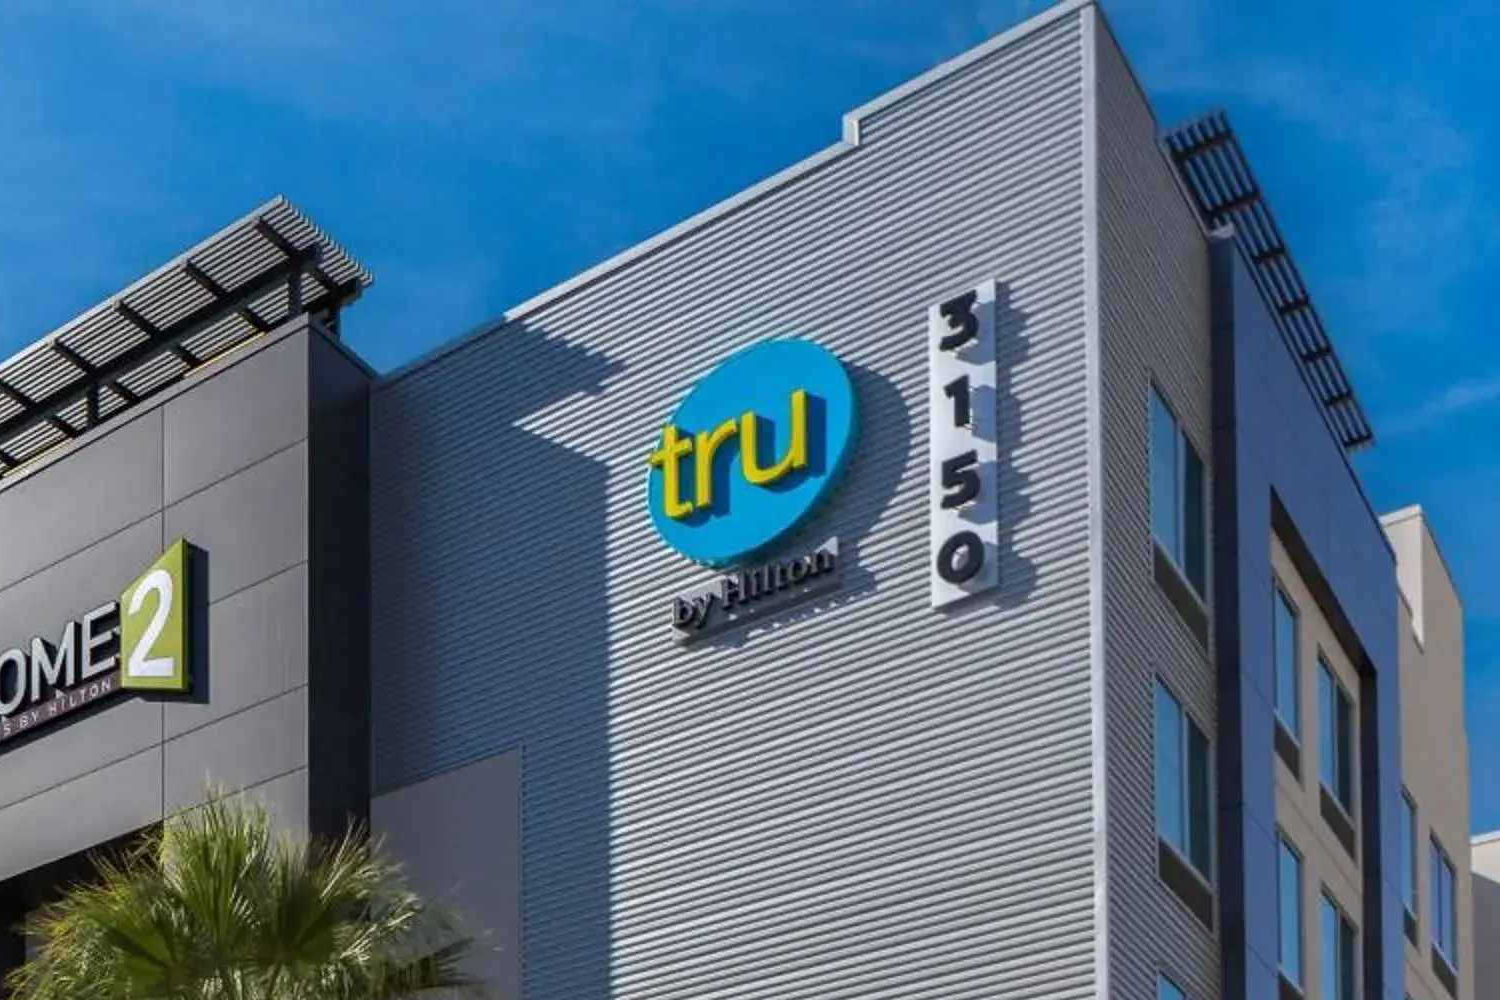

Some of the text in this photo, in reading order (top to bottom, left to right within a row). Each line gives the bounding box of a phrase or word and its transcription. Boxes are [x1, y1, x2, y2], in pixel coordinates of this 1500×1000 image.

[649, 388, 806, 519] tru
[937, 290, 984, 585] 3150
[673, 551, 836, 629] by Hilton
[19, 711, 40, 727] BY
[49, 678, 111, 714] HILTON
